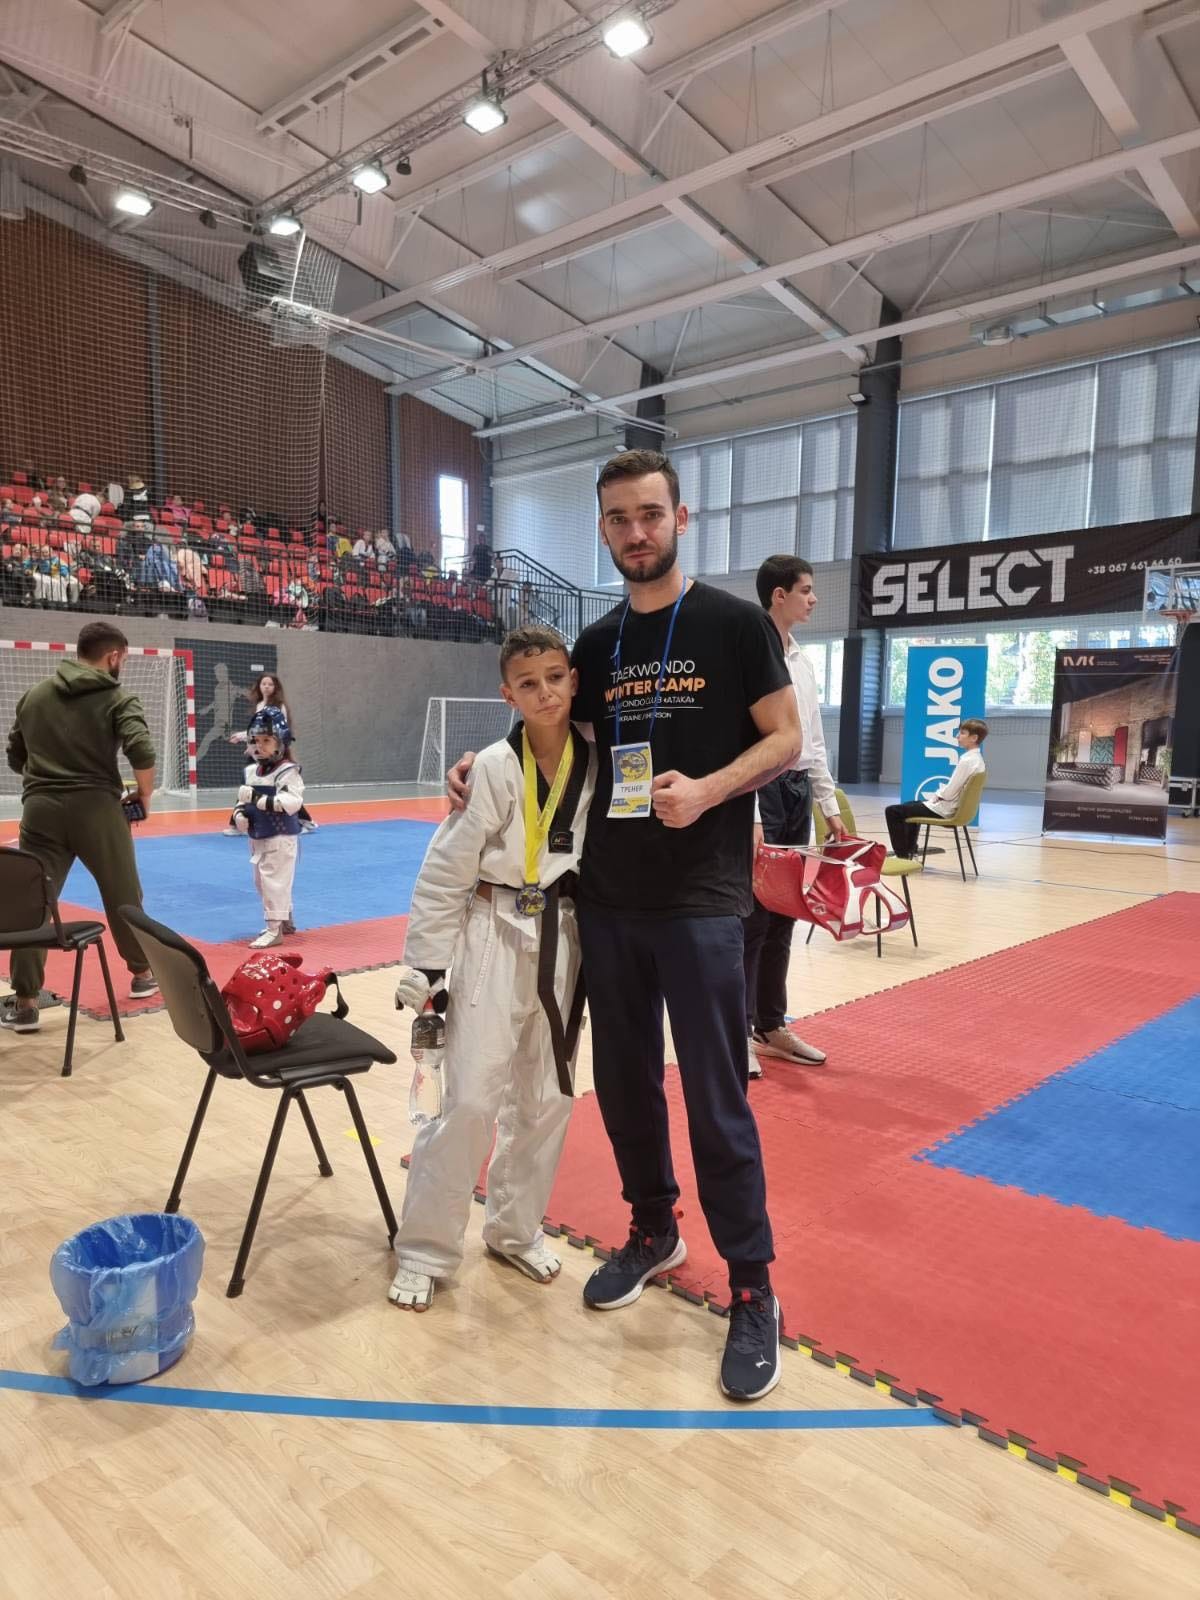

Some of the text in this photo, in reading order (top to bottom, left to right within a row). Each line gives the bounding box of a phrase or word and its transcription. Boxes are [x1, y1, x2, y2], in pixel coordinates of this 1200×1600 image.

[872, 545, 1075, 617] SELECT
[1108, 563, 1127, 573] 067
[610, 660, 695, 684] TAEKWONDO
[604, 677, 706, 703] WINTER CAMP
[924, 657, 964, 766] JAKO
